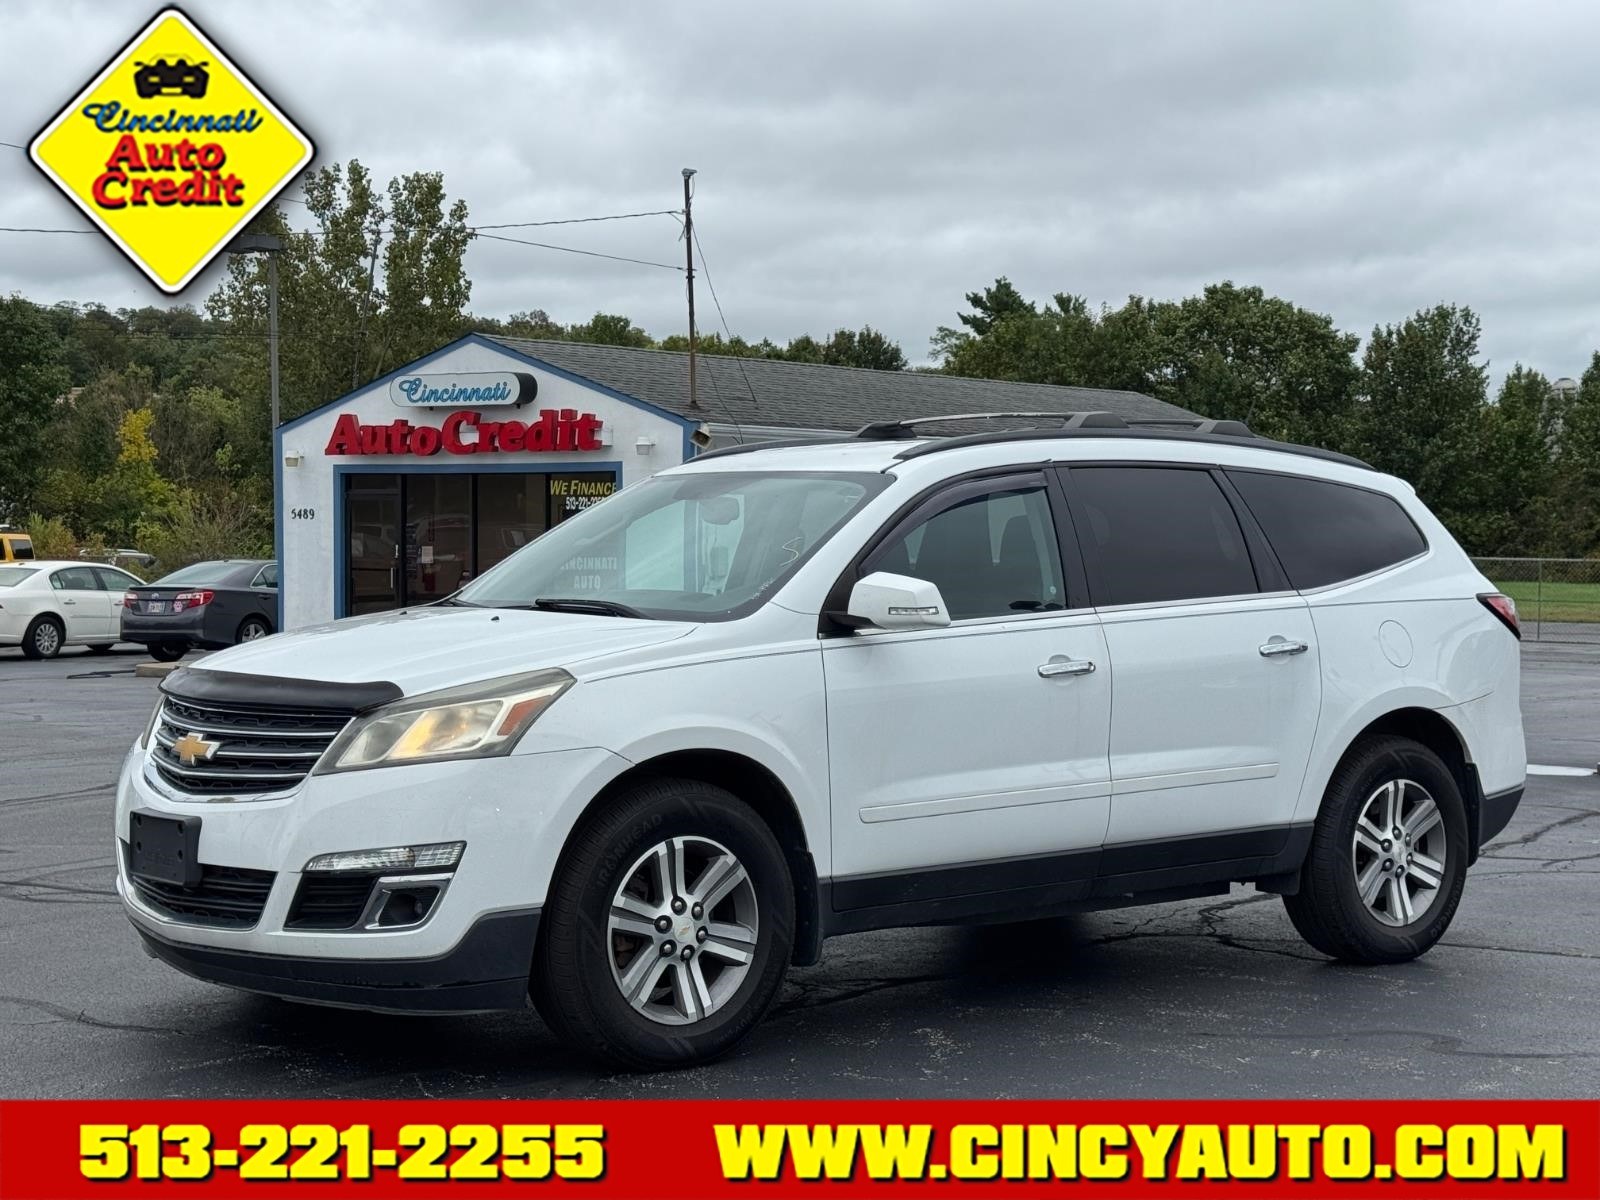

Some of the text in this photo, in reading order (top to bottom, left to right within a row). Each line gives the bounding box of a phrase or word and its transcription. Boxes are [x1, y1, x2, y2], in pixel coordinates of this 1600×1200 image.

[399, 377, 511, 404] Cincinnati
[291, 508, 315, 520] 5489
[574, 574, 601, 590] AUTO
